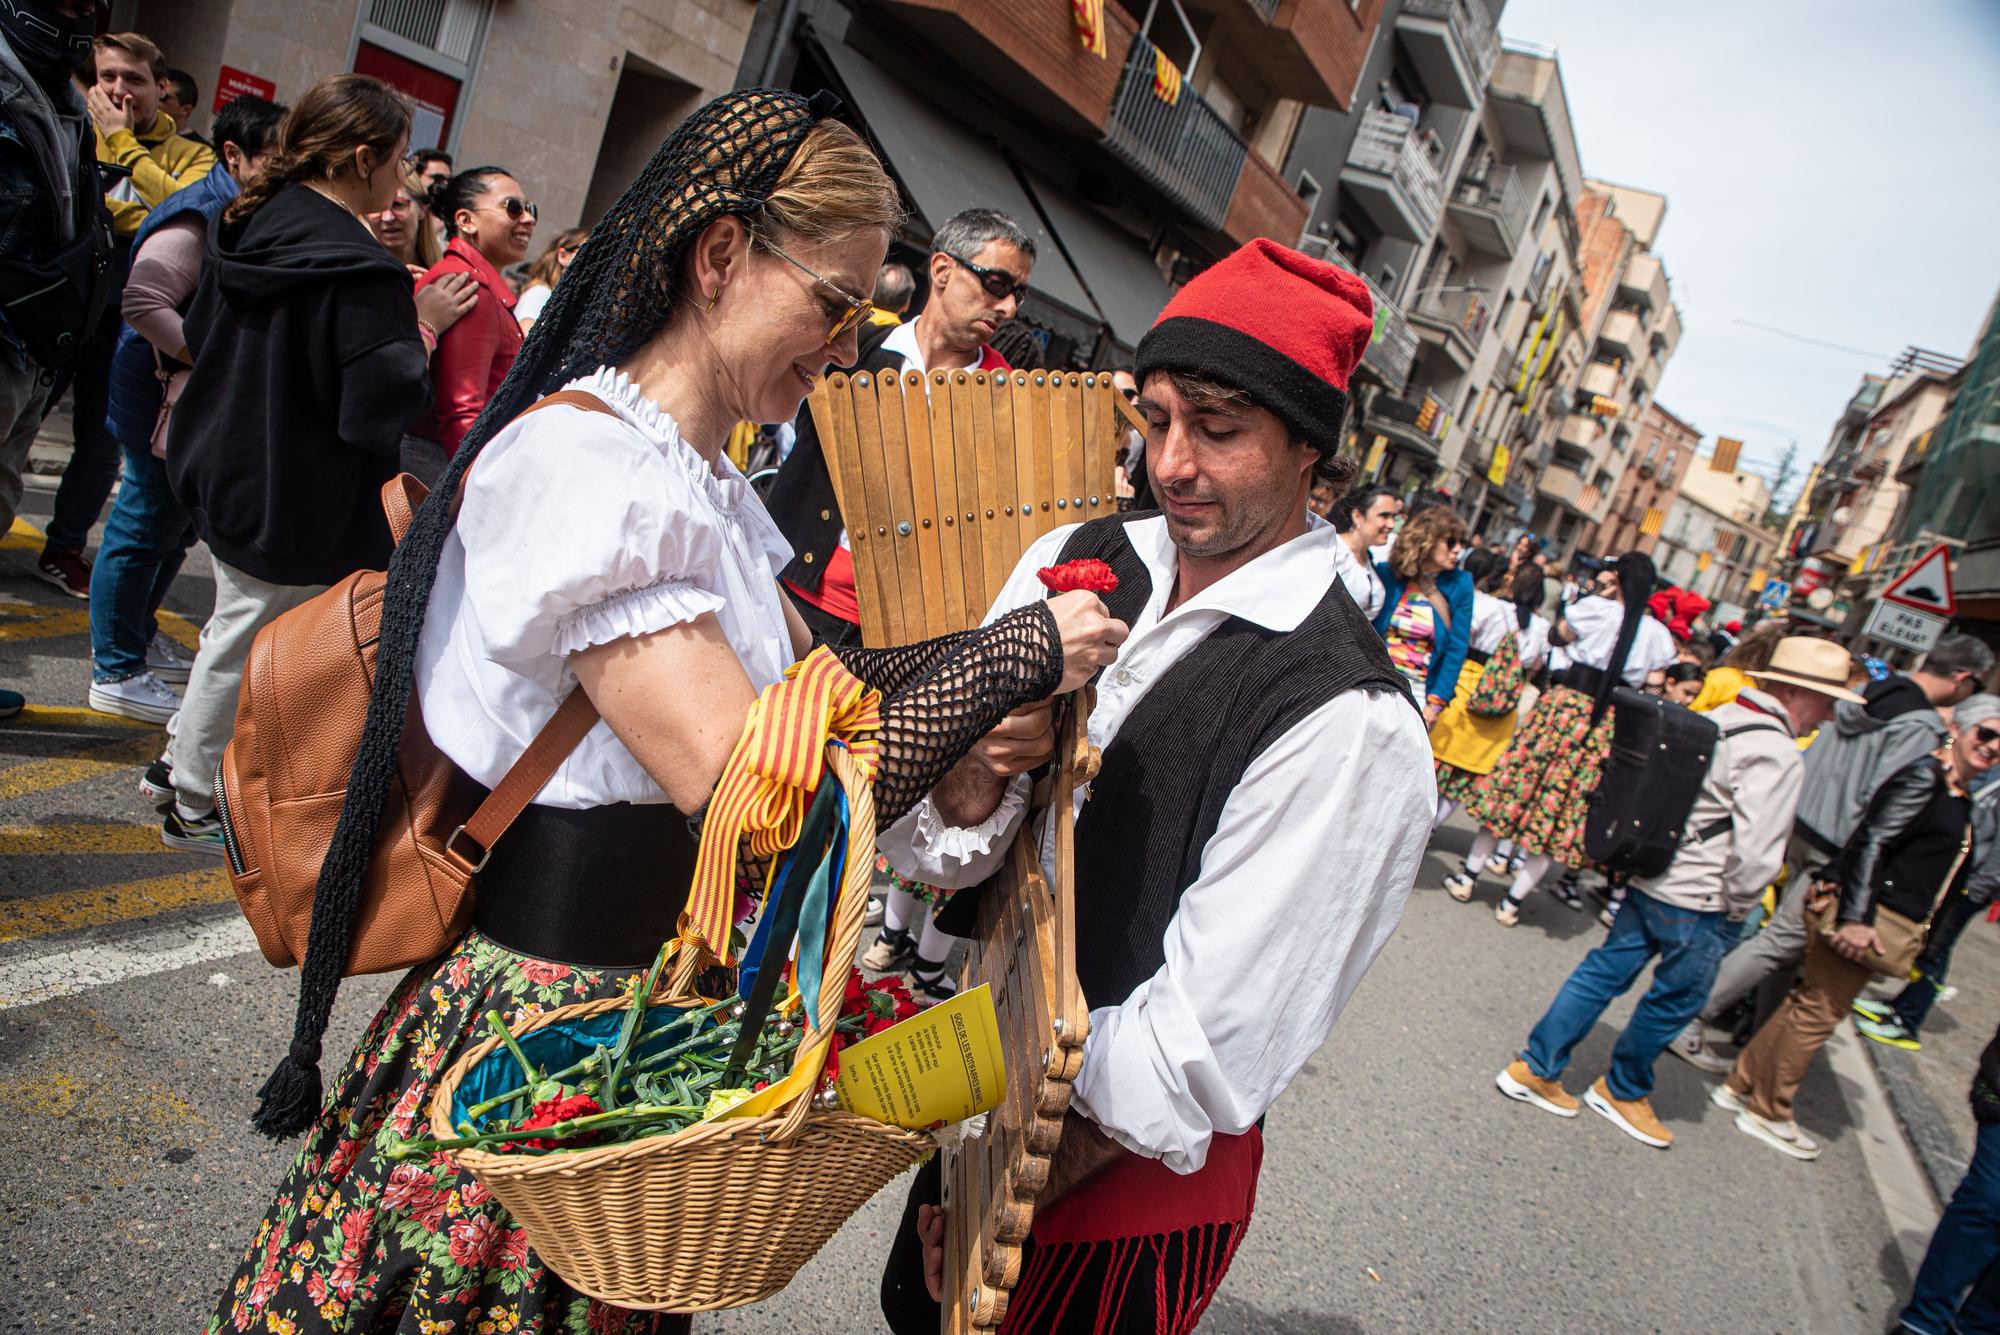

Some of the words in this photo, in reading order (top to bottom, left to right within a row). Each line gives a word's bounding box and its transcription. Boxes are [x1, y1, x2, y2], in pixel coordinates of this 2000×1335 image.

[953, 1012, 964, 1030] GOIG
[958, 1030, 967, 1040] DE
[961, 1039, 971, 1053] LES
[871, 1053, 879, 1063] Que
[874, 1062, 883, 1077] portem
[964, 1052, 979, 1087] BOTIFARRES
